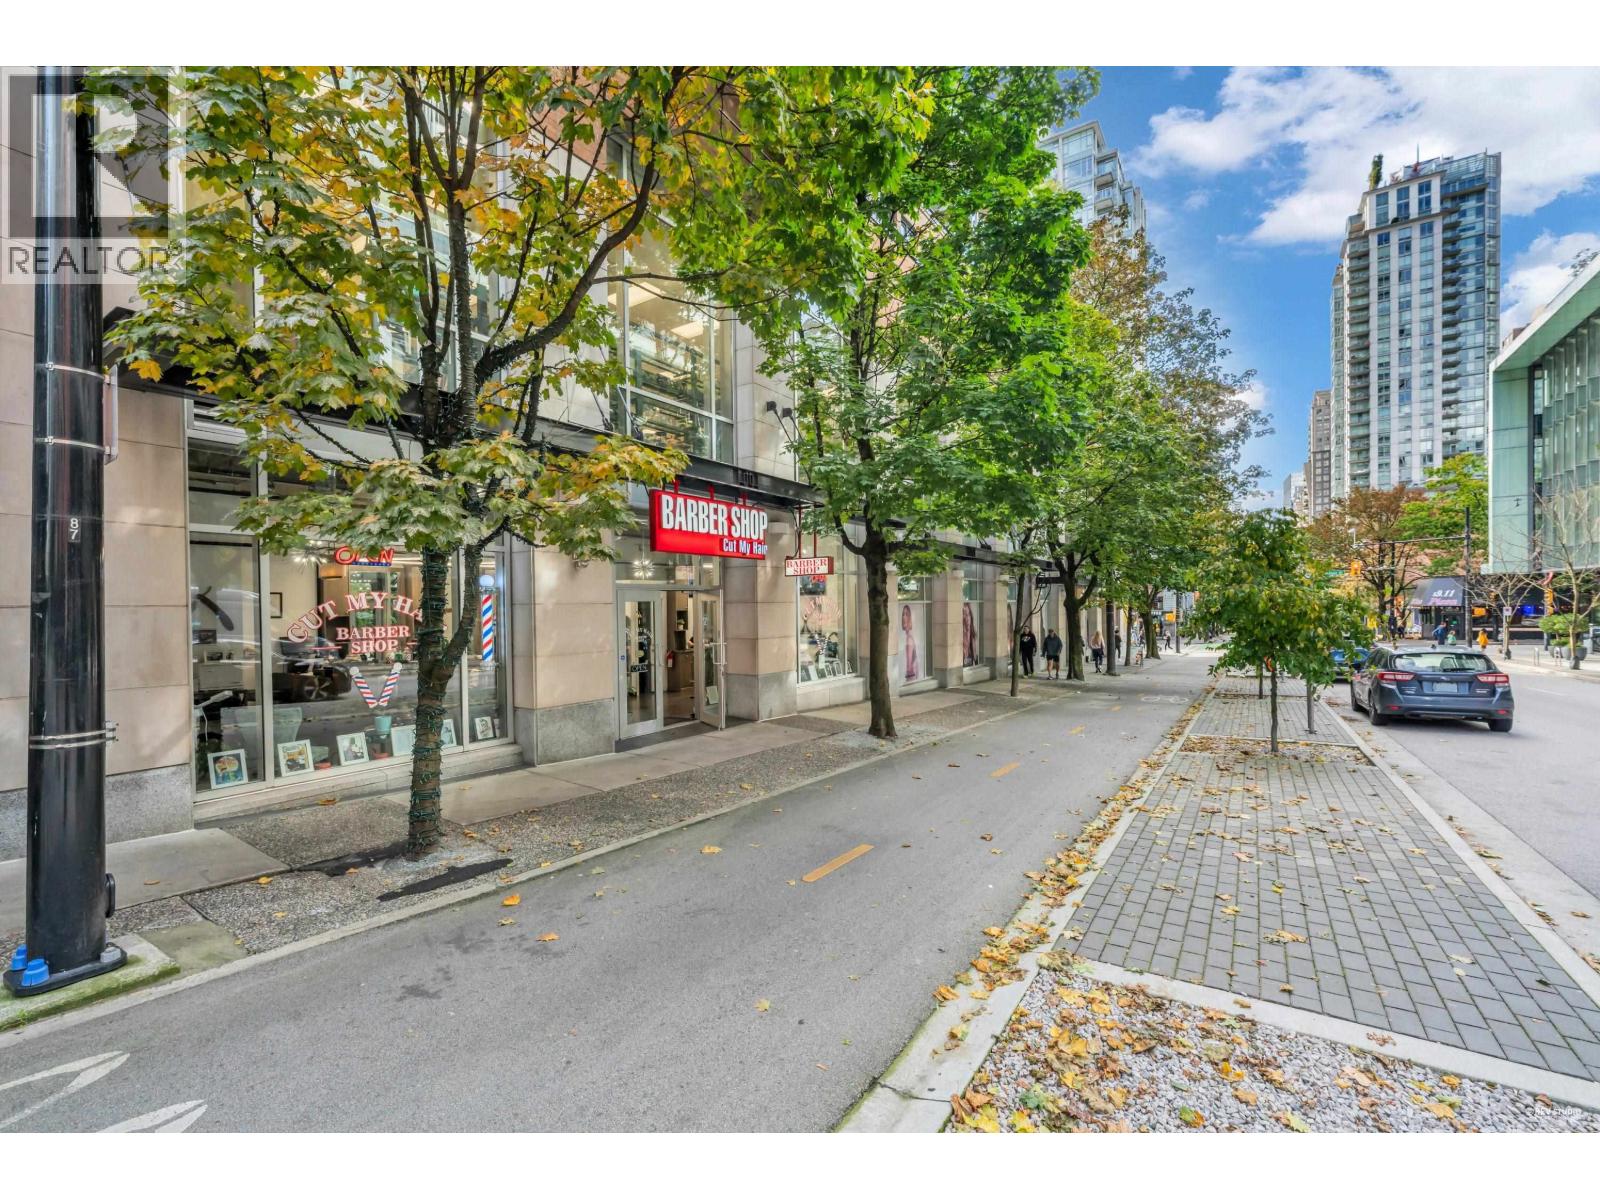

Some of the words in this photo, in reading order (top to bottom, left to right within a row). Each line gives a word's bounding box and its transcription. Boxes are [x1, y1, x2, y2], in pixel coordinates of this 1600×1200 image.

[661, 494, 728, 536] BARBER
[731, 506, 767, 541] SHOP
[723, 538, 736, 553] Cut
[739, 540, 751, 555] My
[753, 541, 768, 555] Hair
[786, 559, 828, 569] BARBER
[793, 567, 820, 575] SHOP
[287, 600, 339, 643] CUT
[345, 592, 388, 612] MY
[393, 594, 423, 622] HA
[336, 625, 410, 641] BARBER
[351, 639, 399, 654] SHOP
